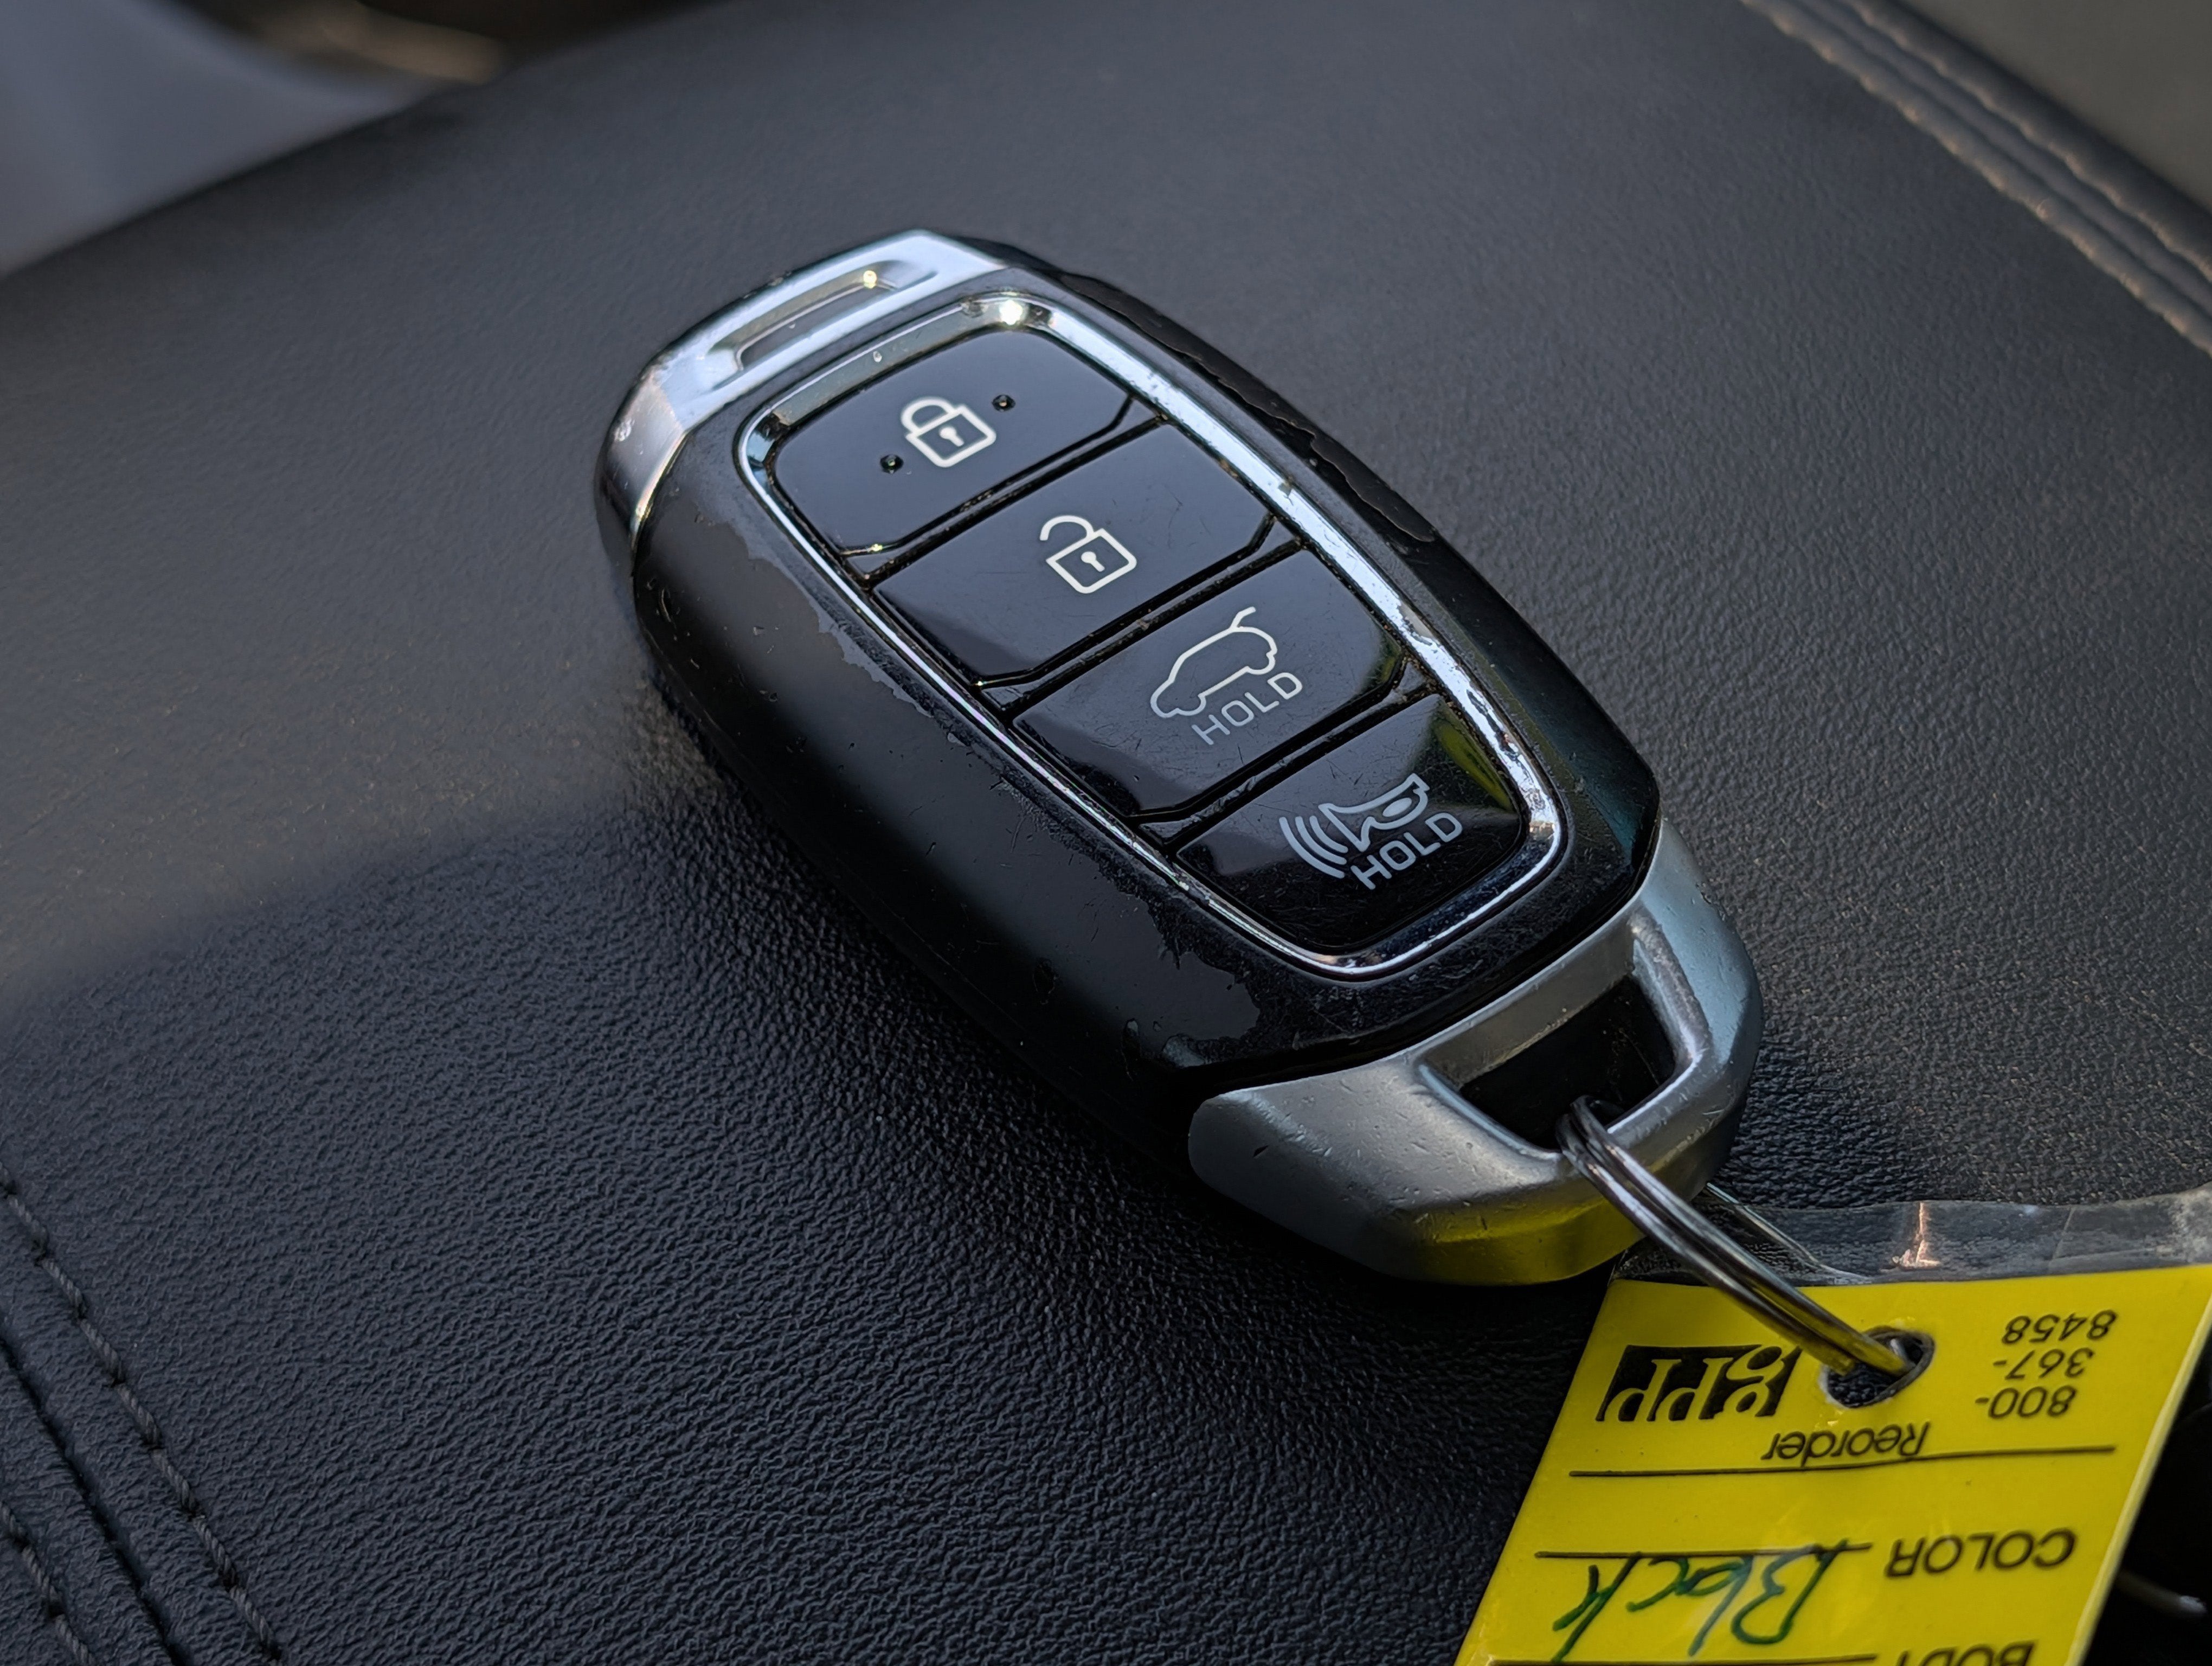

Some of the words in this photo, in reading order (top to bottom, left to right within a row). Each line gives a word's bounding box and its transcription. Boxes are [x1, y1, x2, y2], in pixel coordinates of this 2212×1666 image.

[1192, 672, 1302, 745] HOLD
[1351, 812, 1463, 890] HOLD
[2002, 1310, 2117, 1344] 8458
[1992, 1347, 2094, 1380] 367-
[1975, 1385, 2076, 1419] 800-
[1760, 1421, 1930, 1467] Reorder
[1884, 1527, 2076, 1579] COLOR
[1552, 1537, 1849, 1664] Black
